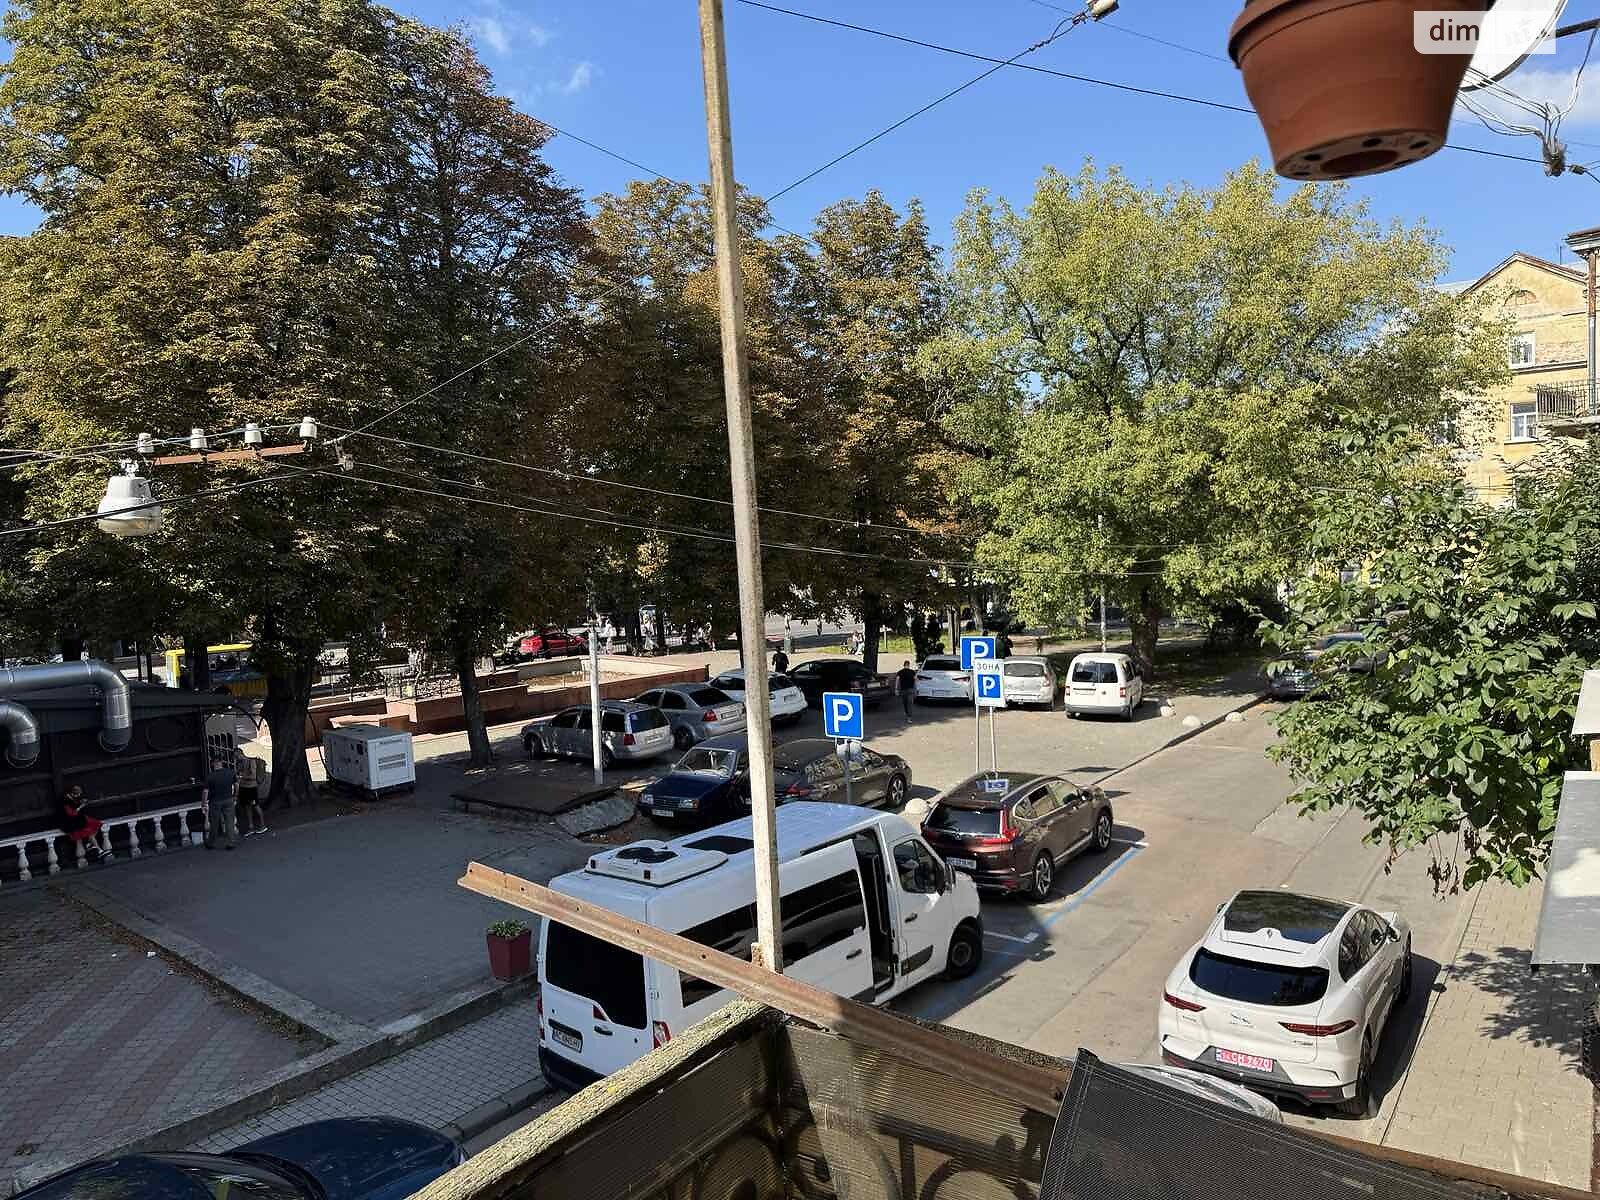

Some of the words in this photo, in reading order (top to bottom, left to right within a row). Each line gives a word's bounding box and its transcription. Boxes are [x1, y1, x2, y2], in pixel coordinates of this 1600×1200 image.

[976, 663, 1001, 671] ЗОНА
[982, 676, 996, 696] P
[832, 698, 854, 733] P
